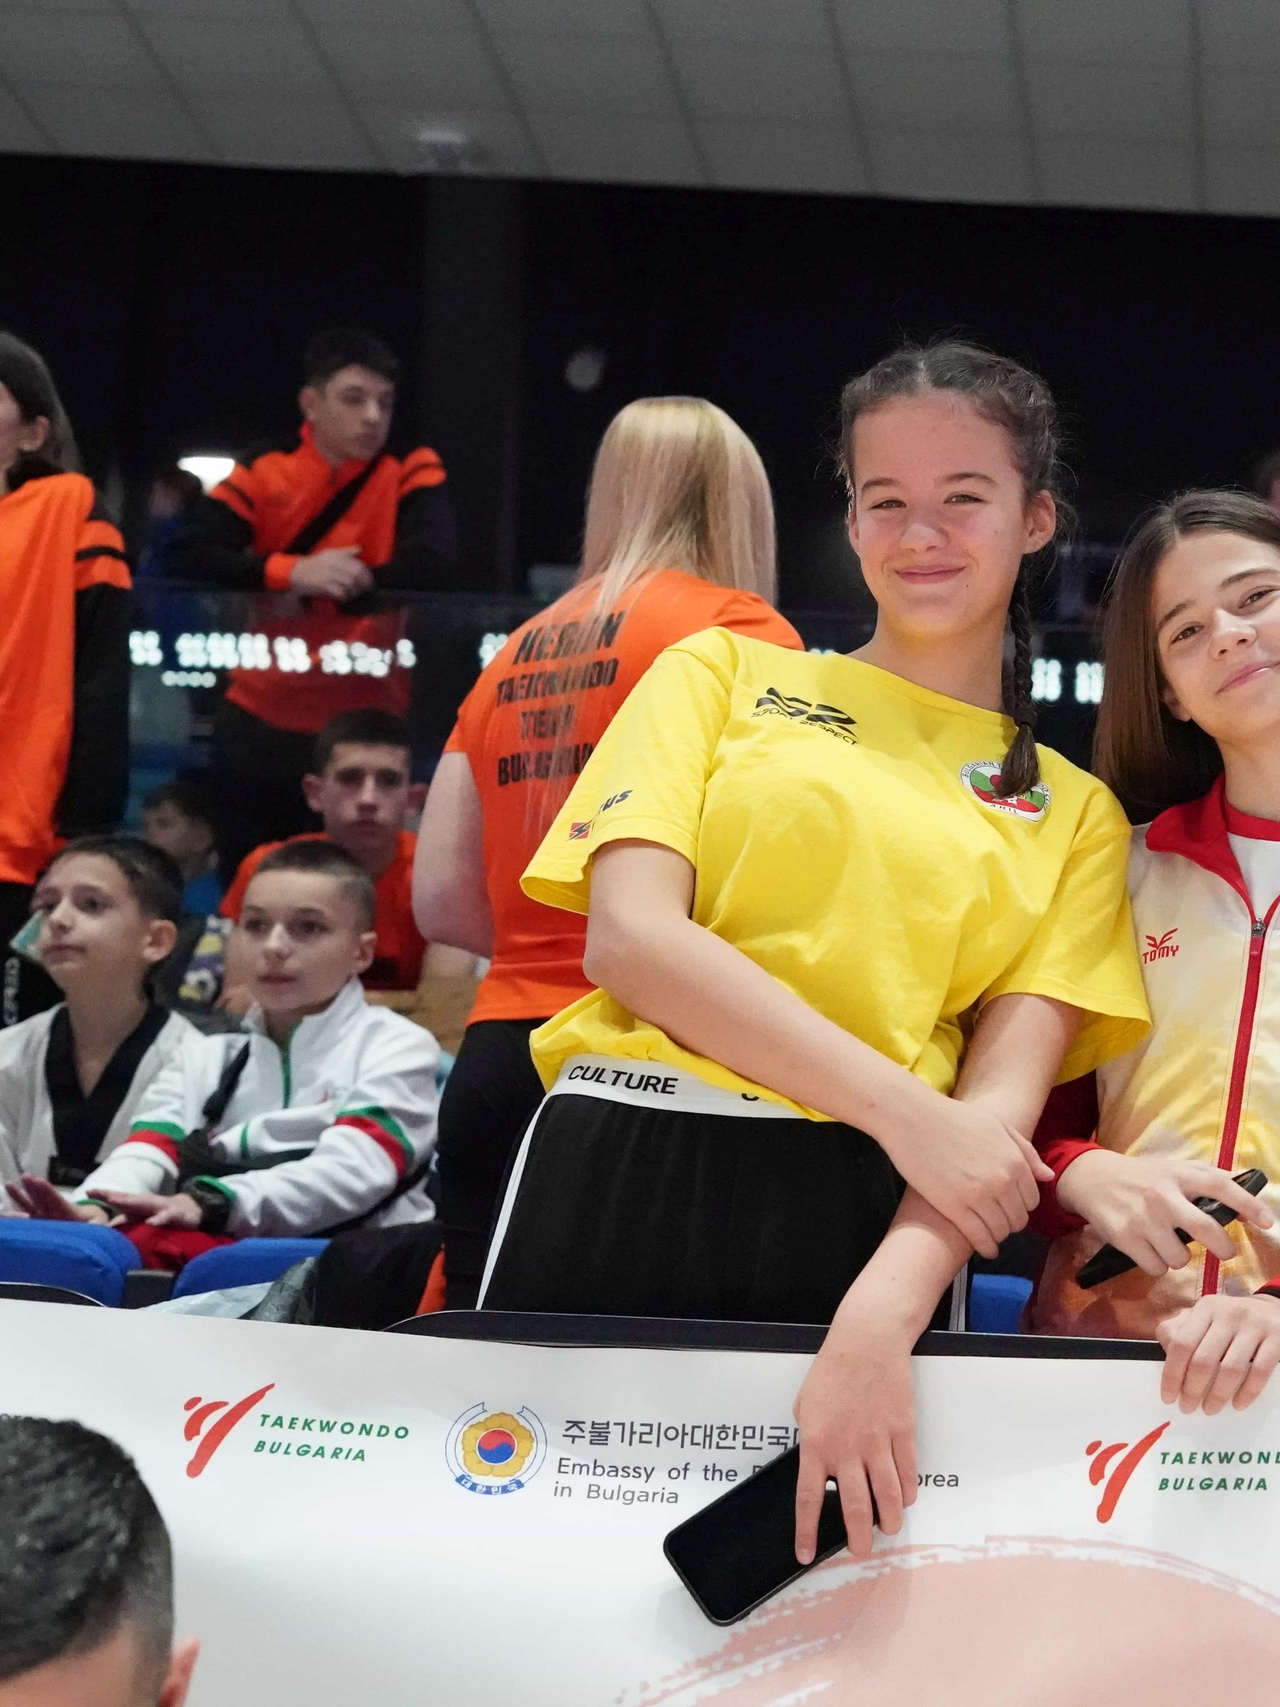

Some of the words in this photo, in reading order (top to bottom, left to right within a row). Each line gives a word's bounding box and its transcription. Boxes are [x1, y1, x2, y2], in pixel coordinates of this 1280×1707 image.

[1142, 945, 1180, 965] TOMY
[567, 1064, 679, 1095] CULTURE
[260, 1414, 410, 1440] TAEKWONDO
[562, 1419, 799, 1453] 주불가리아대한민국
[253, 1440, 366, 1462] BULGARIA
[556, 1457, 656, 1483] Embassy
[667, 1462, 690, 1481] of
[702, 1463, 739, 1482] the
[917, 1473, 960, 1488] rea
[553, 1480, 573, 1498] in
[586, 1484, 680, 1506] Bulgaria
[1158, 1477, 1268, 1491] BULGARIA
